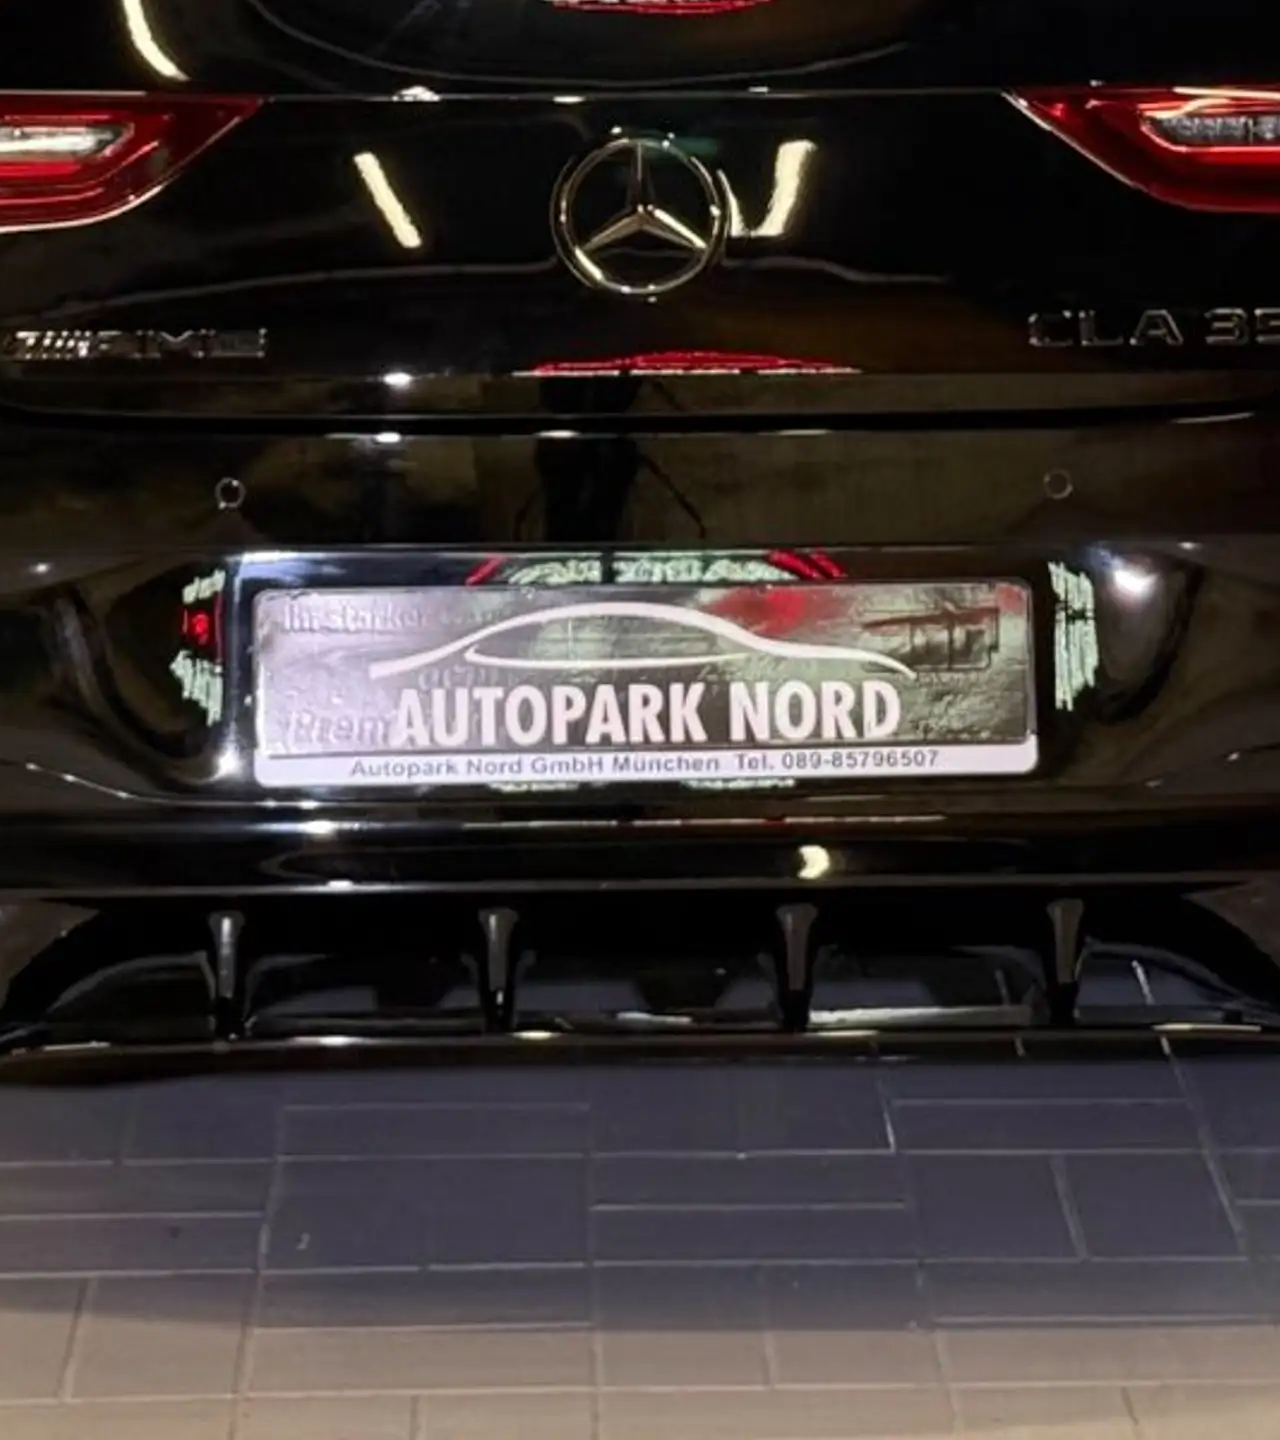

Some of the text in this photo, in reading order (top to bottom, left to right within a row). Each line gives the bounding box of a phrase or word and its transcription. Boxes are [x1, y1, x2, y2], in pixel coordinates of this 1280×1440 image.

[1028, 308, 1184, 347] CLA
[395, 679, 902, 748] AUTOPARK NORD
[349, 749, 938, 779] Autopark Nord GmbH München Tel. 089-85796507
